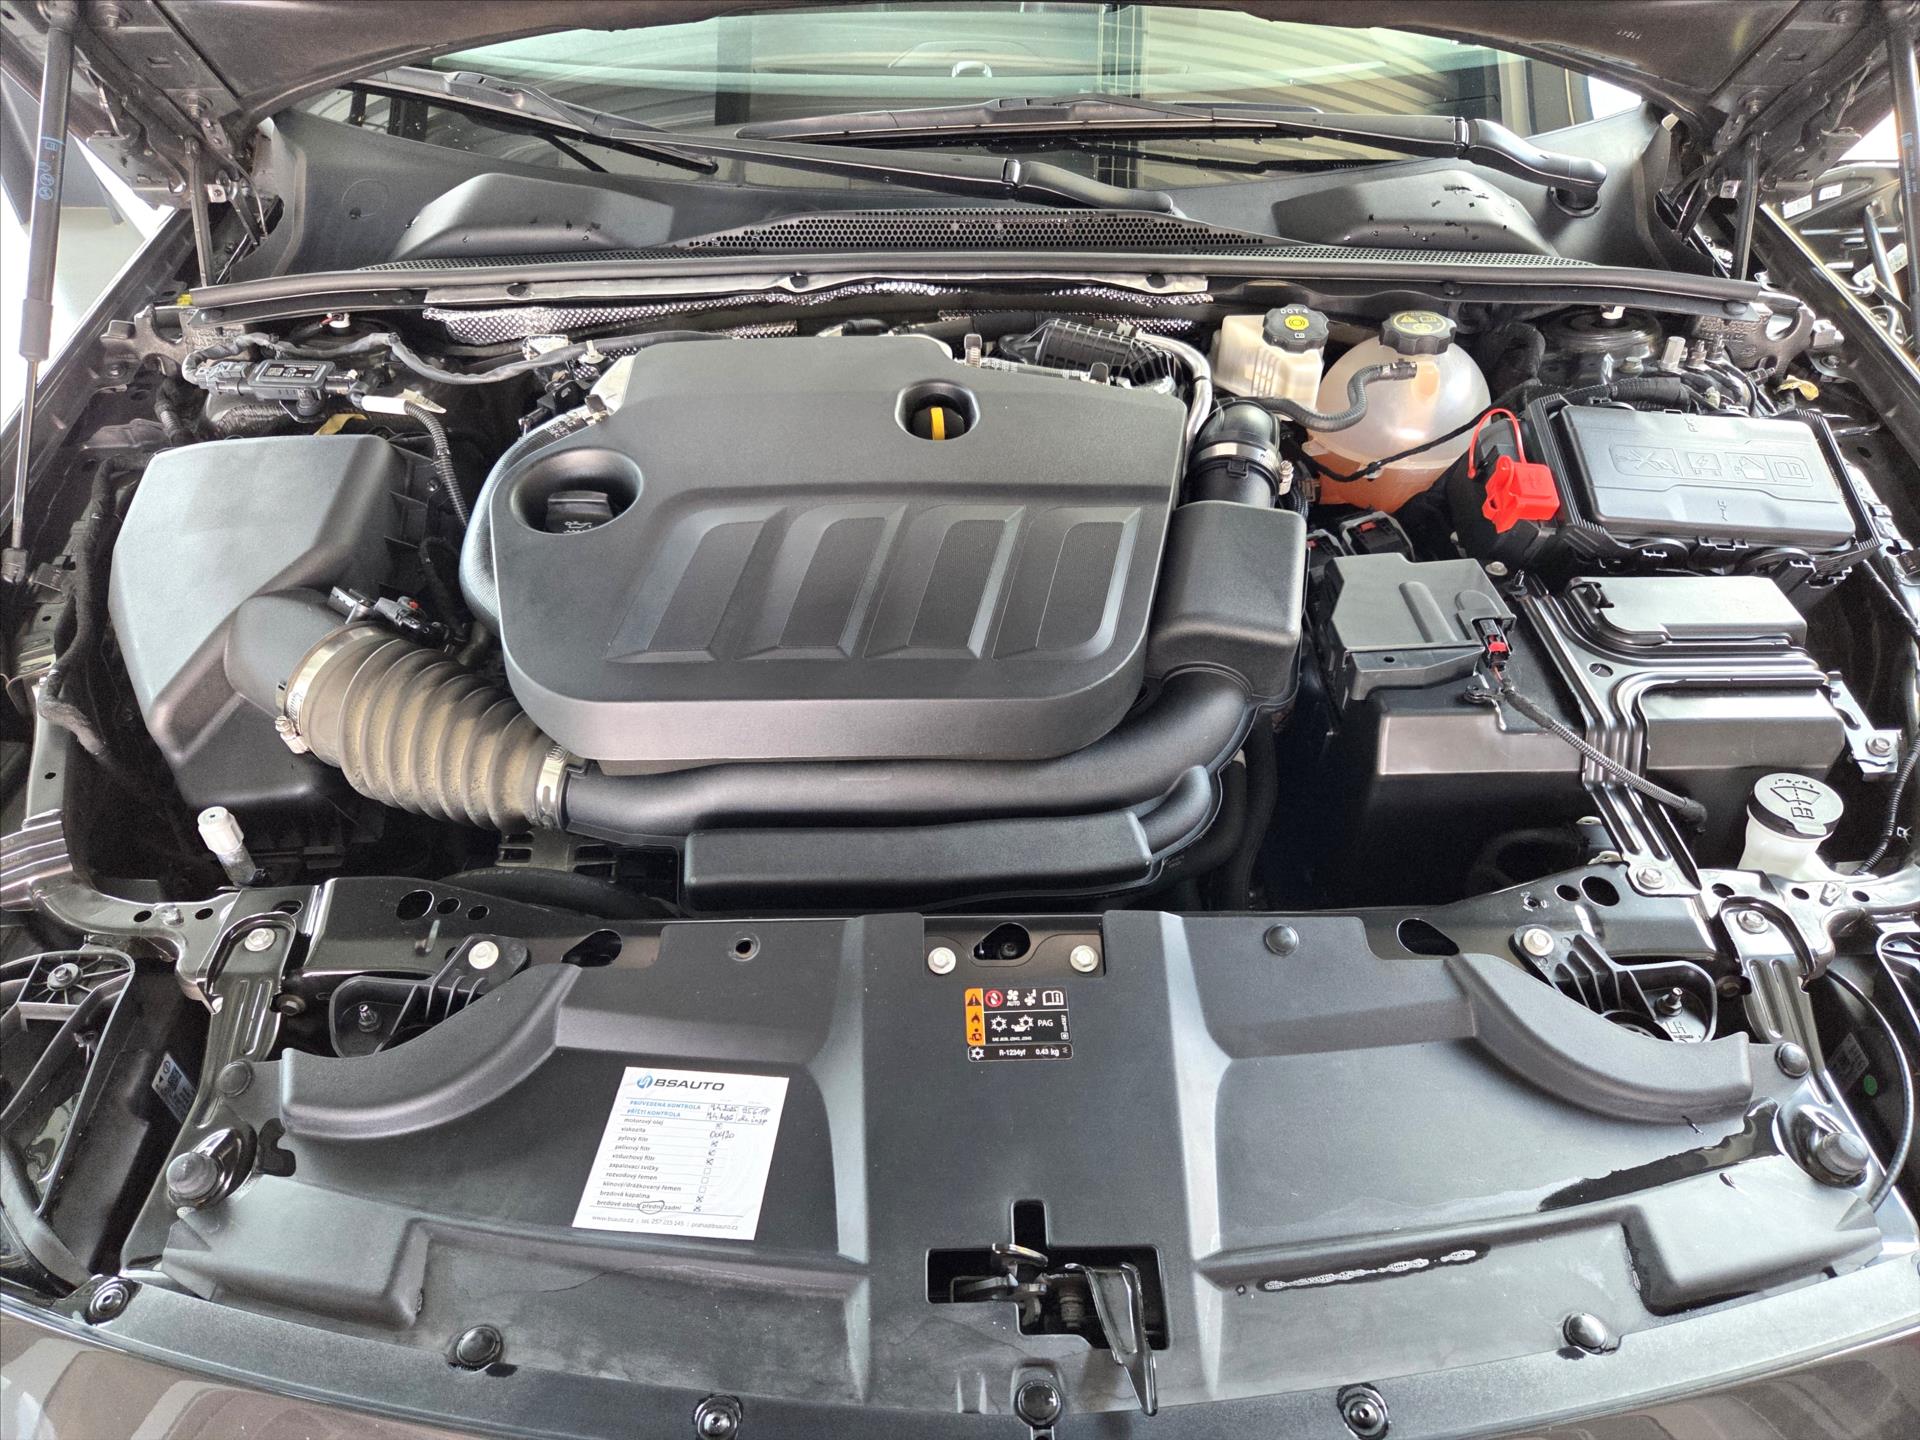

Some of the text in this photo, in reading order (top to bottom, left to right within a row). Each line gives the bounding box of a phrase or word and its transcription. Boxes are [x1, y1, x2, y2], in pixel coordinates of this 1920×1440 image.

[1037, 1019, 1054, 1027] PAG
[999, 1049, 1026, 1057] R-1234yf
[1050, 1048, 1060, 1057] kg
[653, 1078, 725, 1092] BSAUTO
[624, 1117, 652, 1125] motorový
[612, 1153, 643, 1161] vzduchový
[605, 1171, 637, 1180] rozvodový
[624, 1191, 651, 1199] kapalina
